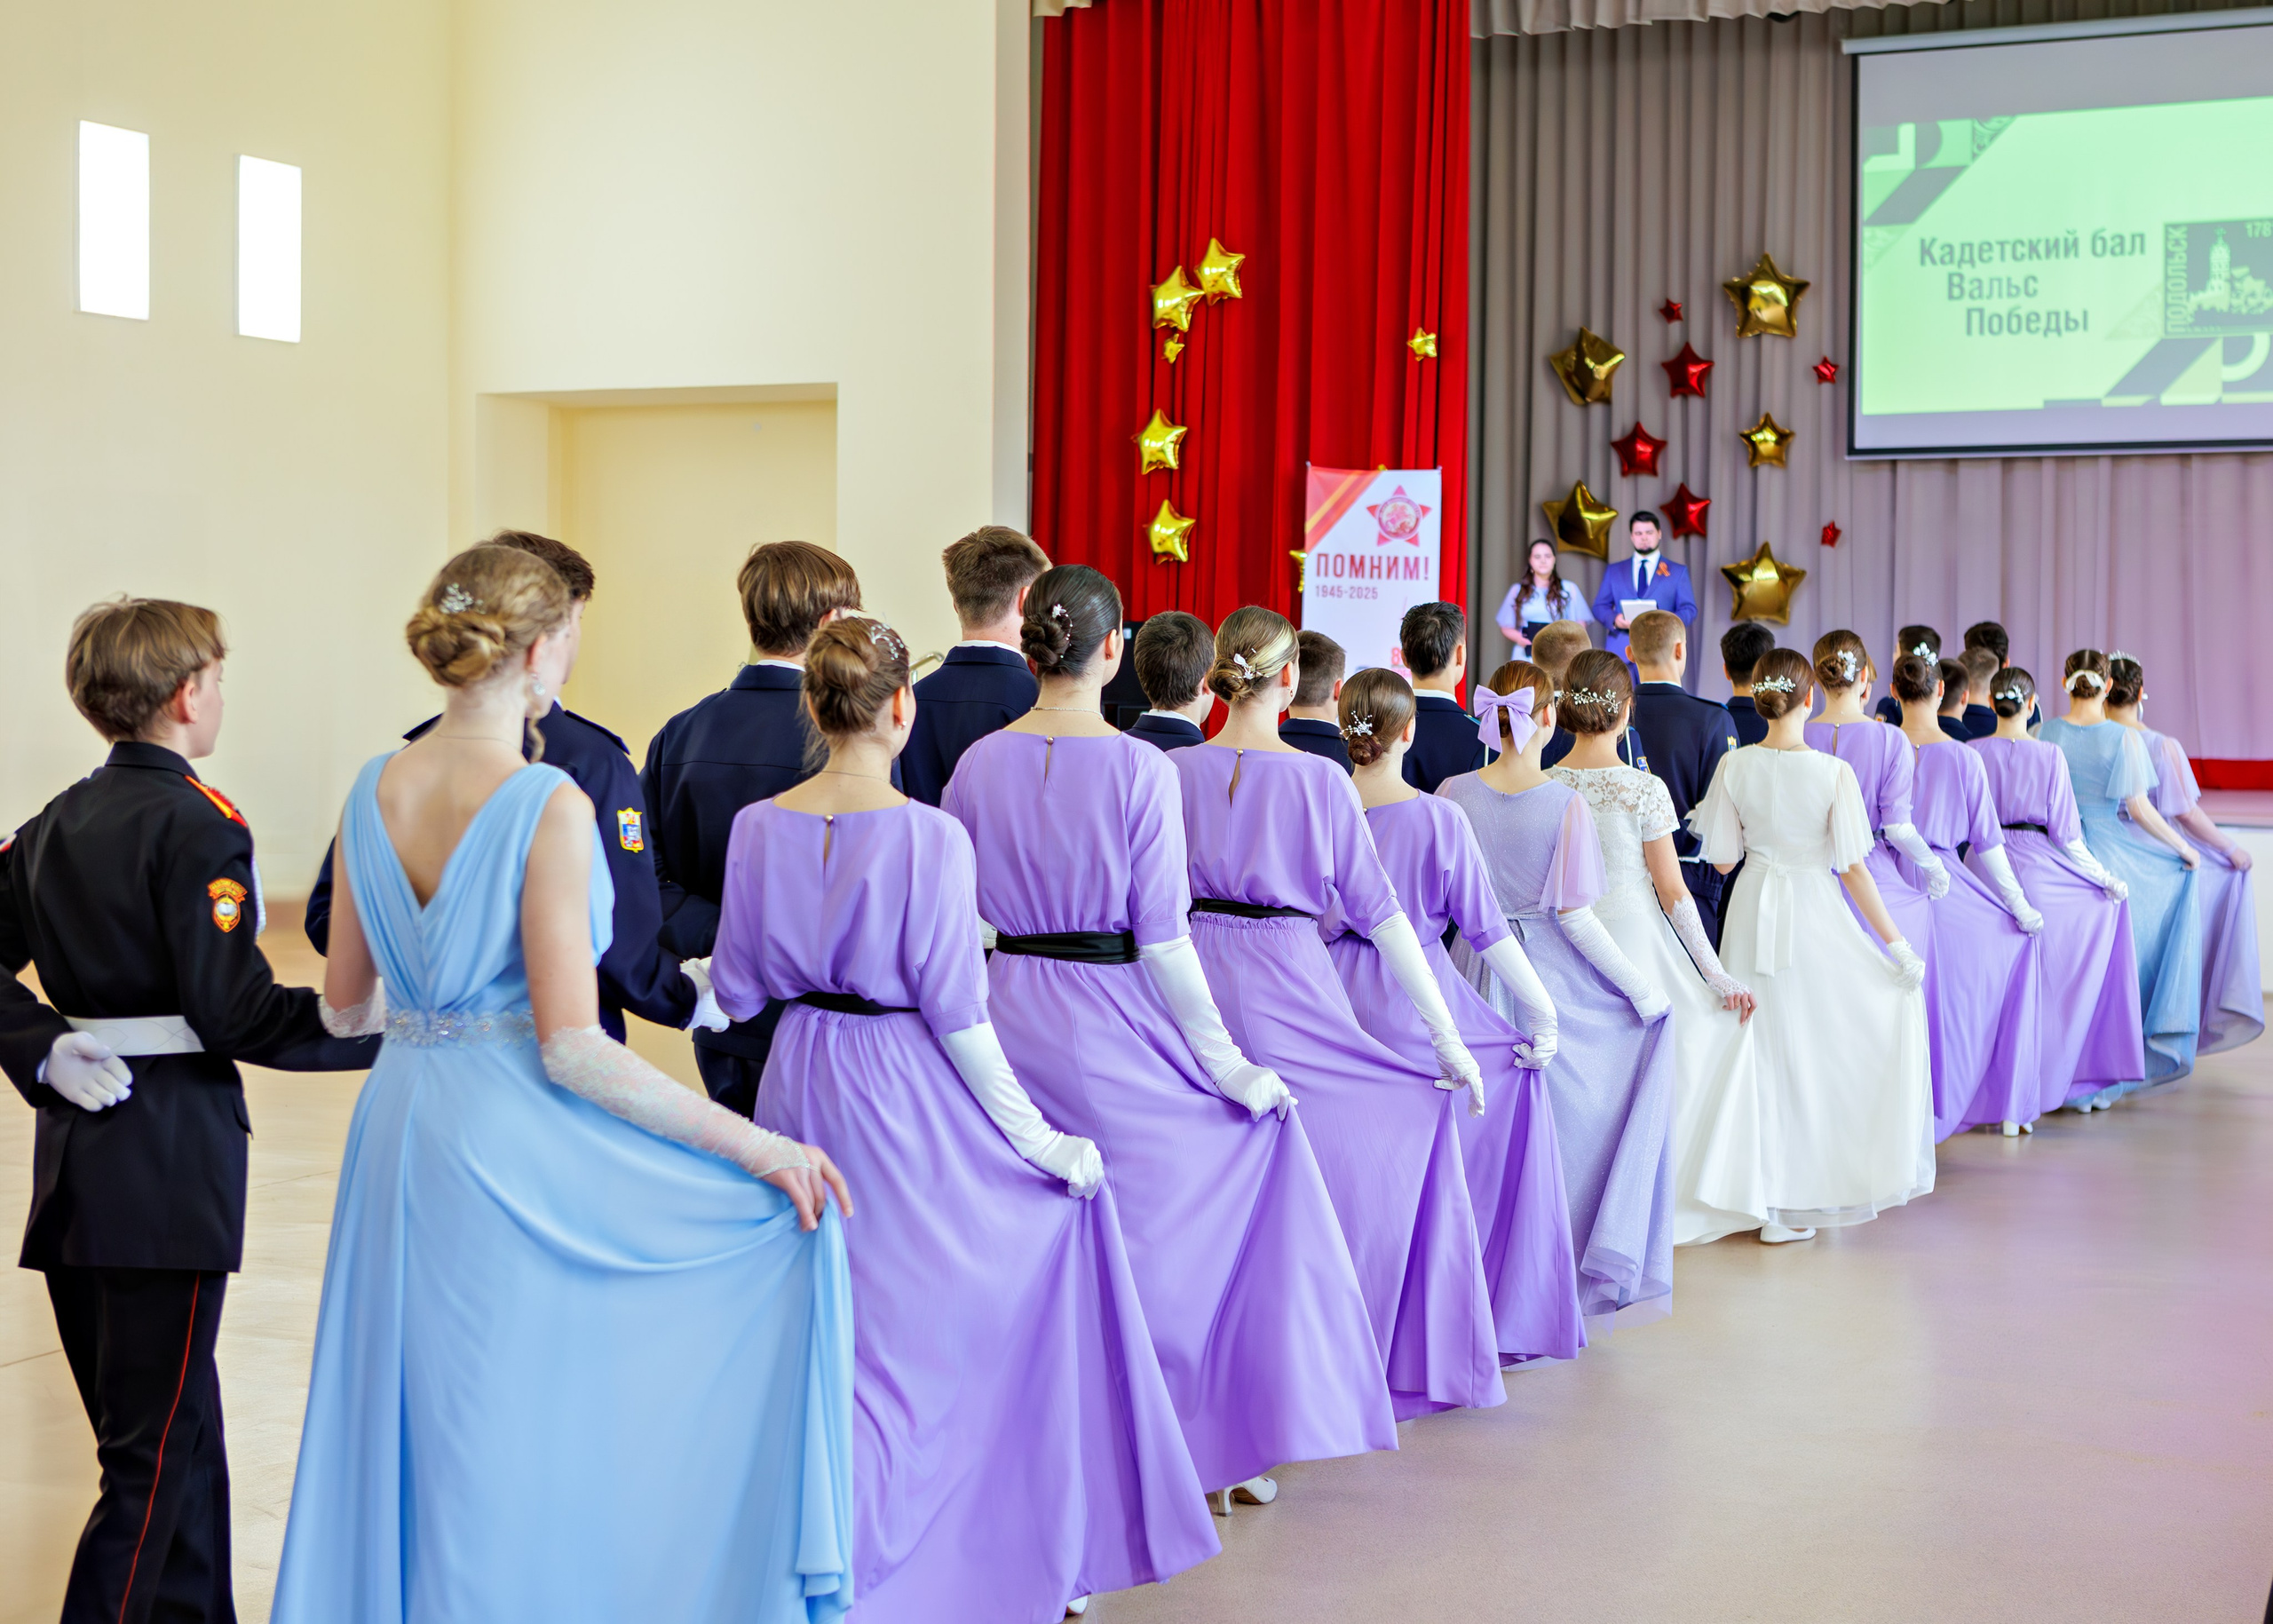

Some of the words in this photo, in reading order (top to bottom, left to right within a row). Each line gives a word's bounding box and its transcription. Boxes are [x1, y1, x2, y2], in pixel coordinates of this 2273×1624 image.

[2245, 221, 2273, 238] 178
[1919, 229, 2079, 269] Кадетский
[2091, 227, 2145, 257] бал
[1947, 271, 2039, 302] Вальс
[2166, 226, 2188, 333] ПОДОЛЬСК
[1965, 305, 2088, 338] Победы
[1316, 553, 1429, 580] ПОМНИМ!
[1316, 585, 1378, 599] 1945-2025
